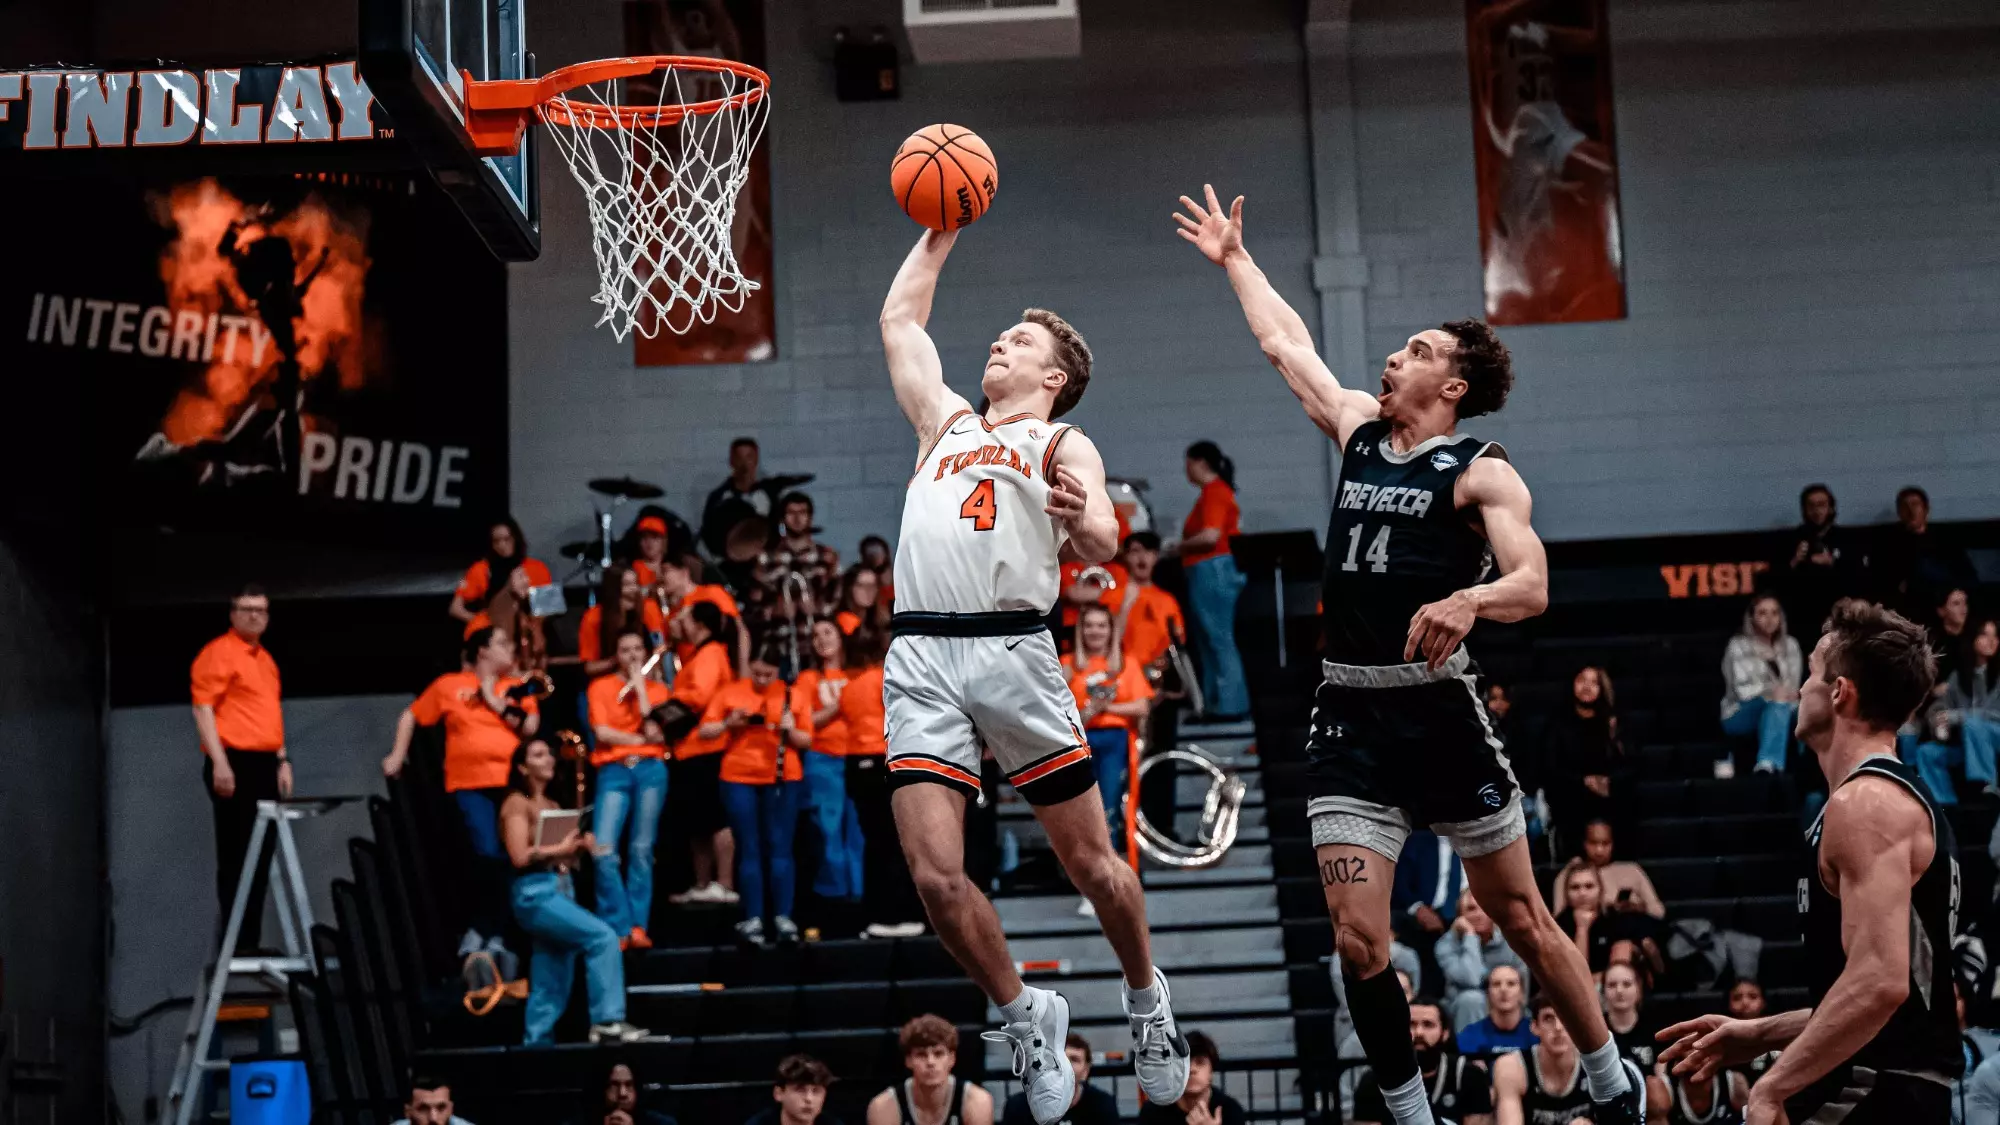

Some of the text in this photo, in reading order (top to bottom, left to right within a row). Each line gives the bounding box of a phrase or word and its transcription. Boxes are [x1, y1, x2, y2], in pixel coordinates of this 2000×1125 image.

[27, 292, 272, 368] INTEGRITY
[298, 432, 470, 508] PRIDE
[959, 478, 998, 532] 4
[1338, 480, 1433, 519] TREVECCA
[1341, 522, 1392, 573] 14
[1660, 561, 1770, 599] VISI
